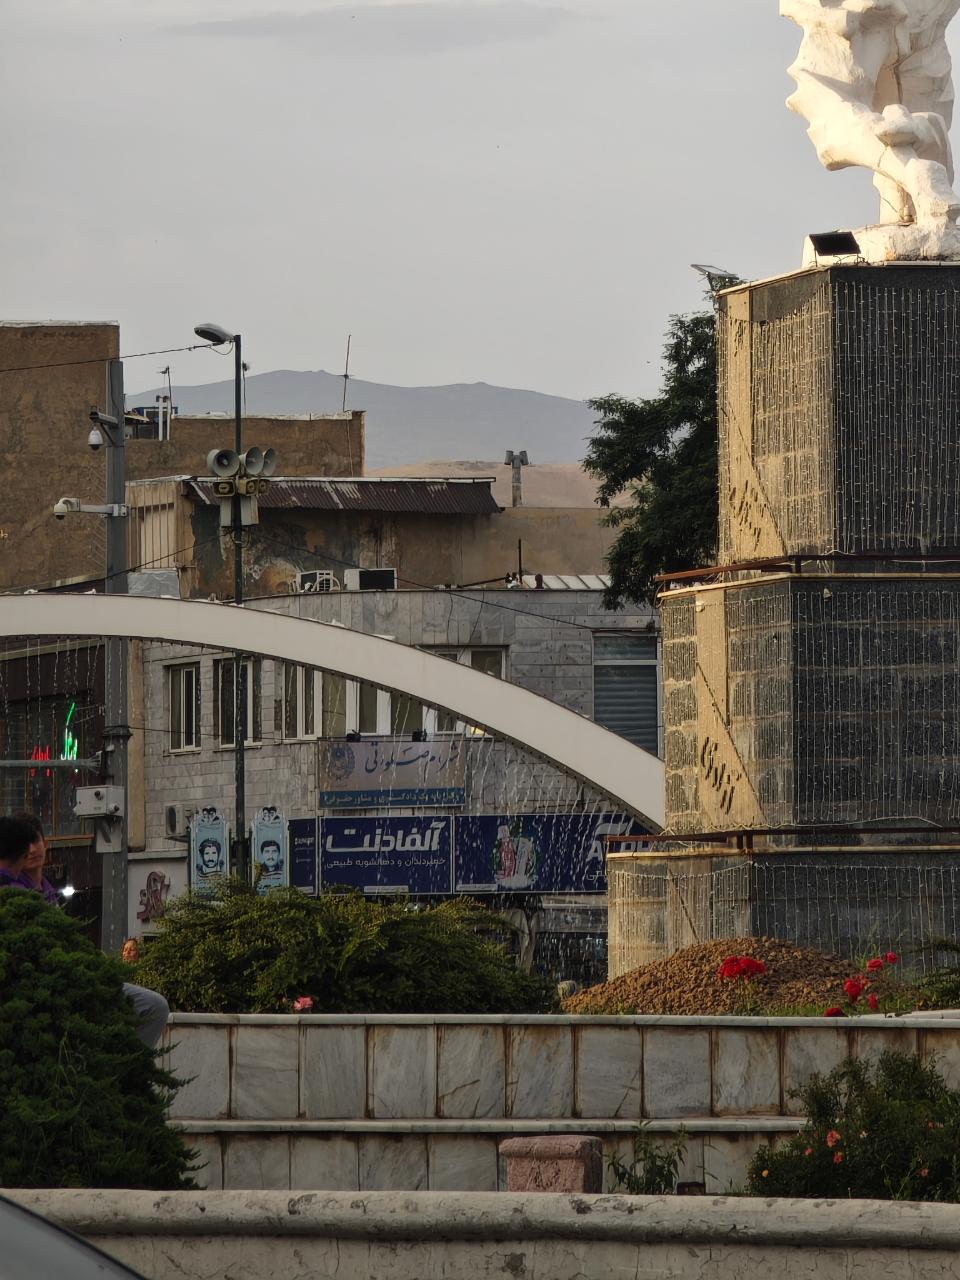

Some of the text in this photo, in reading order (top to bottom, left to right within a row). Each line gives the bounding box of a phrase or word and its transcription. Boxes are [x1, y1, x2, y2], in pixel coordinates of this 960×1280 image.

[326, 821, 446, 852] آلفادنت
[326, 857, 353, 869] طبیعی
[355, 858, 395, 868] دهانشویه
[405, 857, 446, 867] خمیردندان
